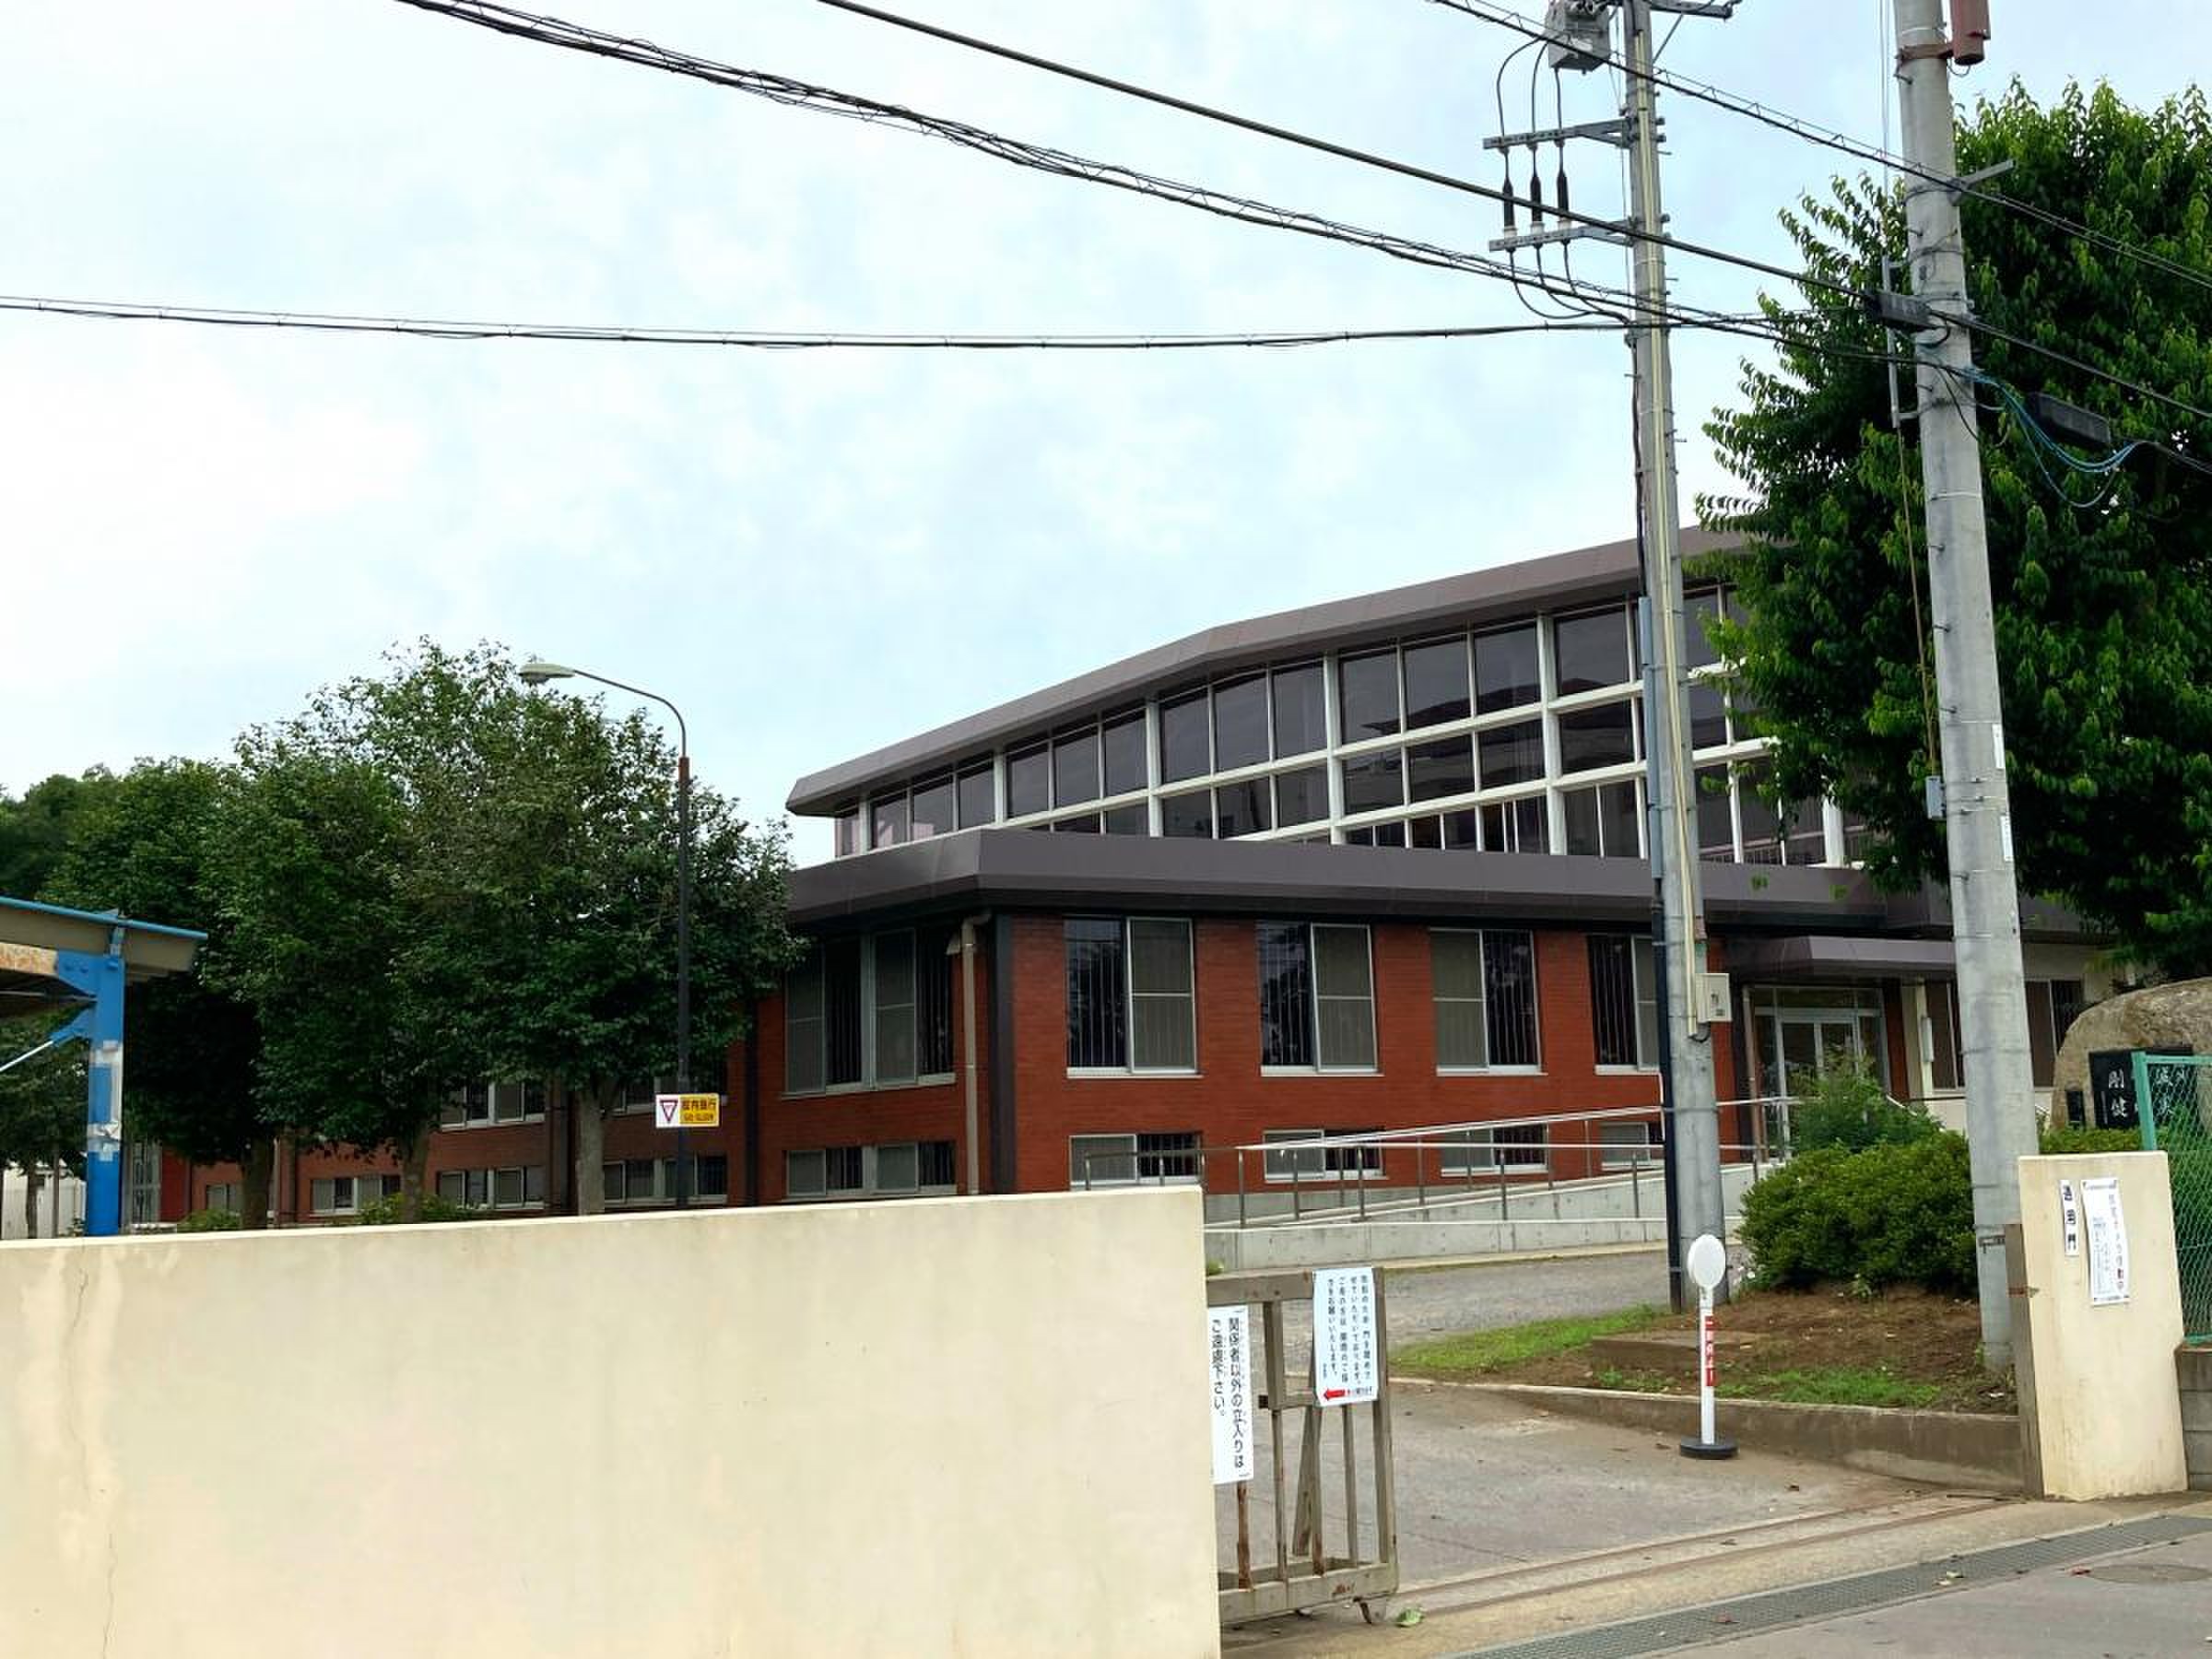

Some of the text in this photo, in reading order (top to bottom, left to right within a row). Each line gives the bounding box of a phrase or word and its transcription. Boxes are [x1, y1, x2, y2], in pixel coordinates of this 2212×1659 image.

[1212, 1319, 1226, 1417] ご遠慮下さい。
[1229, 1317, 1244, 1469] 関係者以外の立入りは
